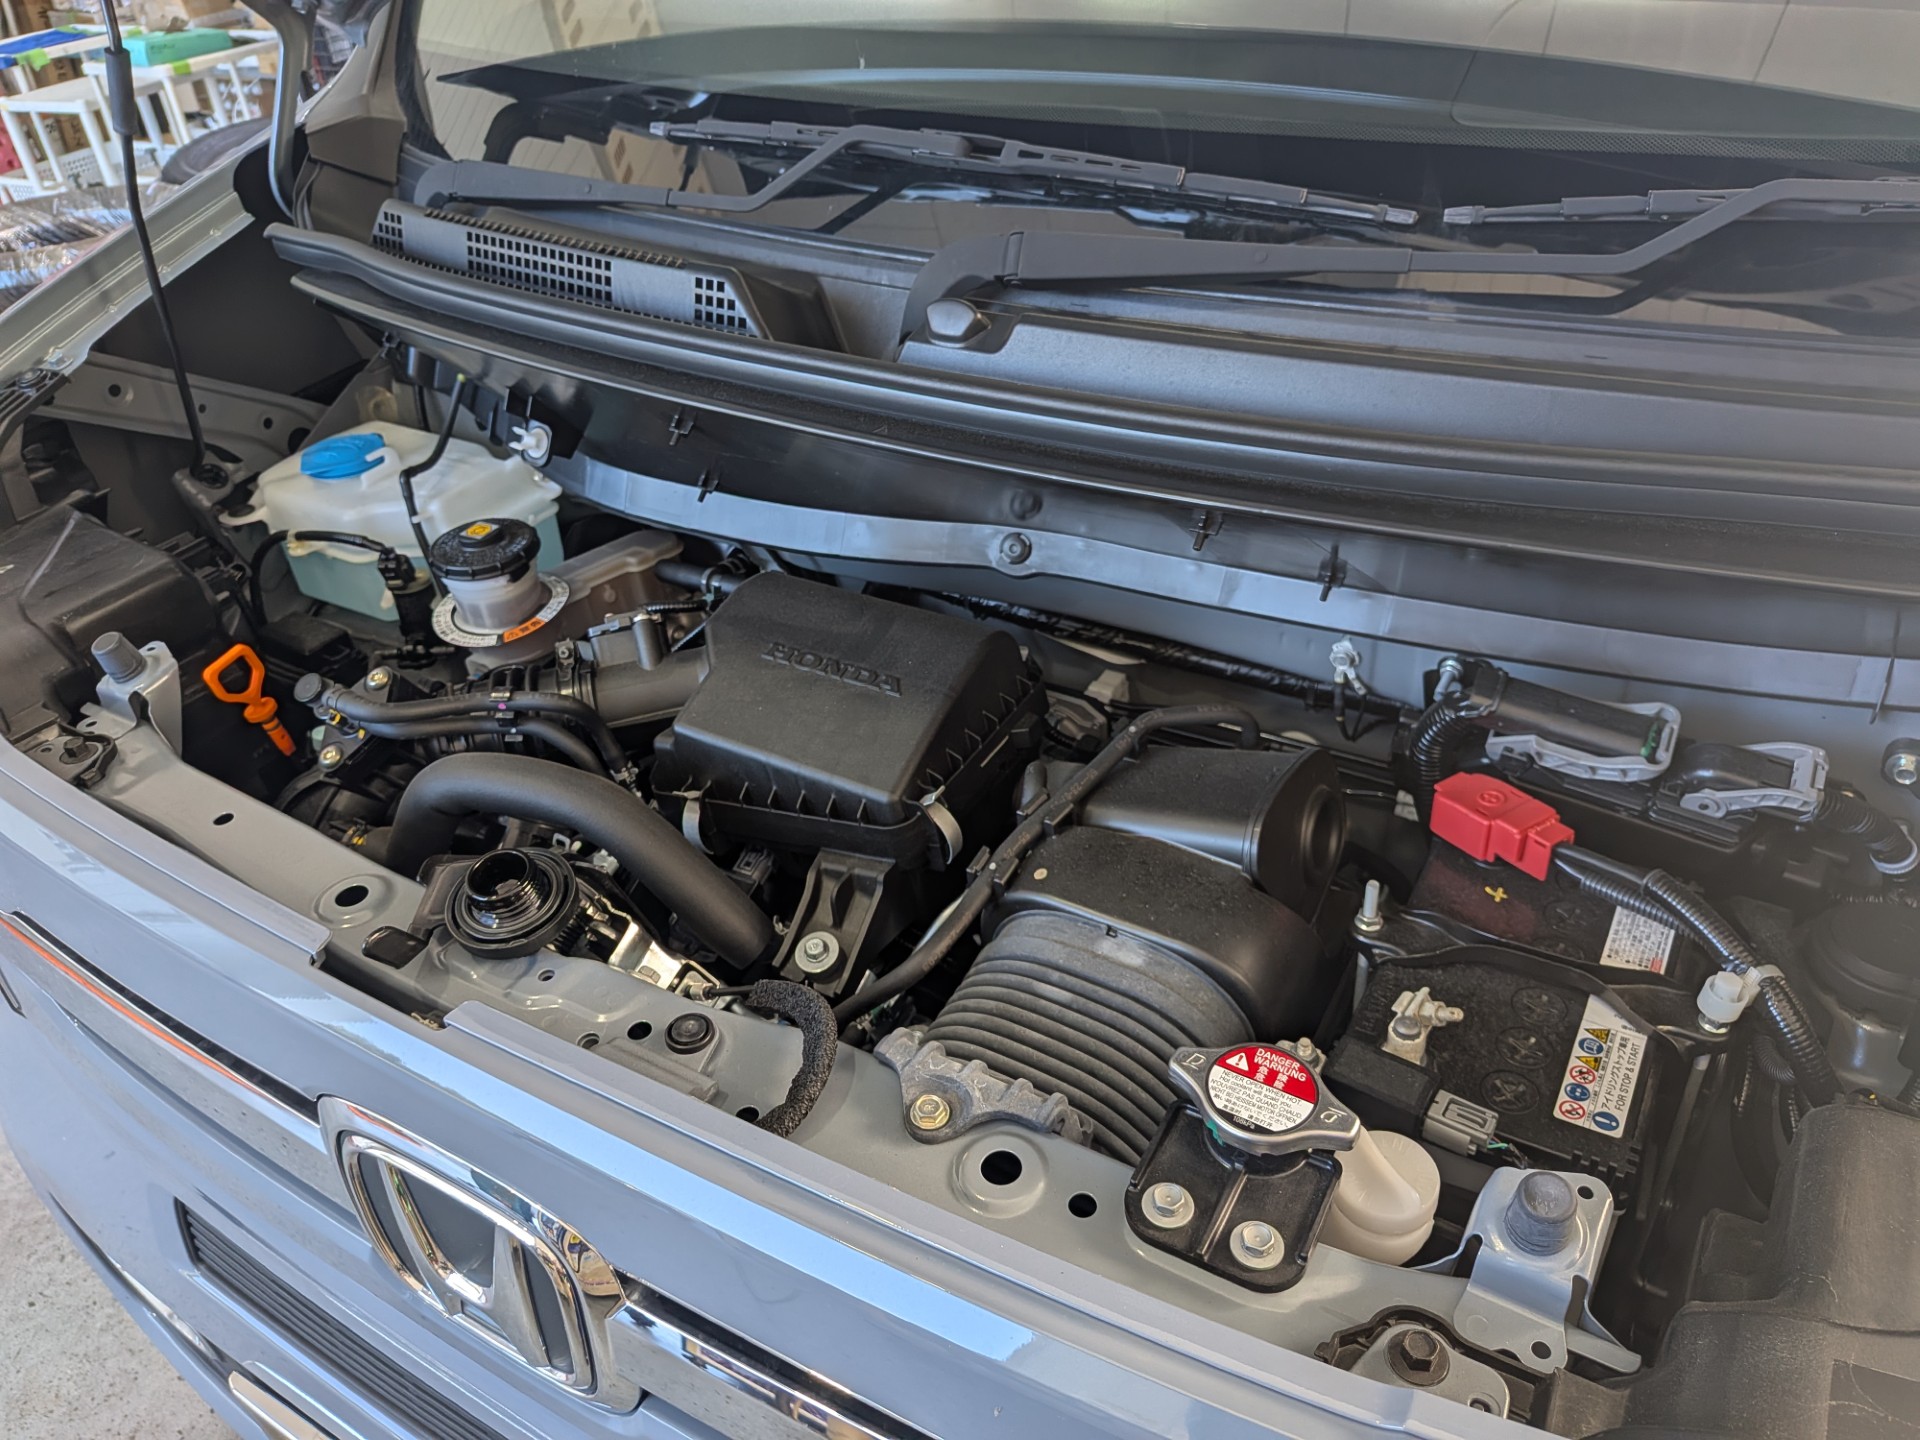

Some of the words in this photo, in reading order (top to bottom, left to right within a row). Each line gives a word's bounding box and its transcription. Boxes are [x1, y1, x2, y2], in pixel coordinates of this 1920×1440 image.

[761, 642, 902, 698] HONDA
[1256, 1048, 1300, 1071] DANGER
[1626, 1041, 1640, 1066] START
[1219, 1074, 1230, 1083] Hot
[1254, 1056, 1306, 1082] WARNUNG
[1221, 1069, 1244, 1082] NEVER
[1245, 1079, 1264, 1090] OPEN
[1265, 1086, 1285, 1098] WHEN
[1618, 1072, 1632, 1094] STOP
[1241, 1090, 1255, 1100] PAS
[1254, 1096, 1278, 1109] QUAND
[1613, 1093, 1627, 1111] FOR
